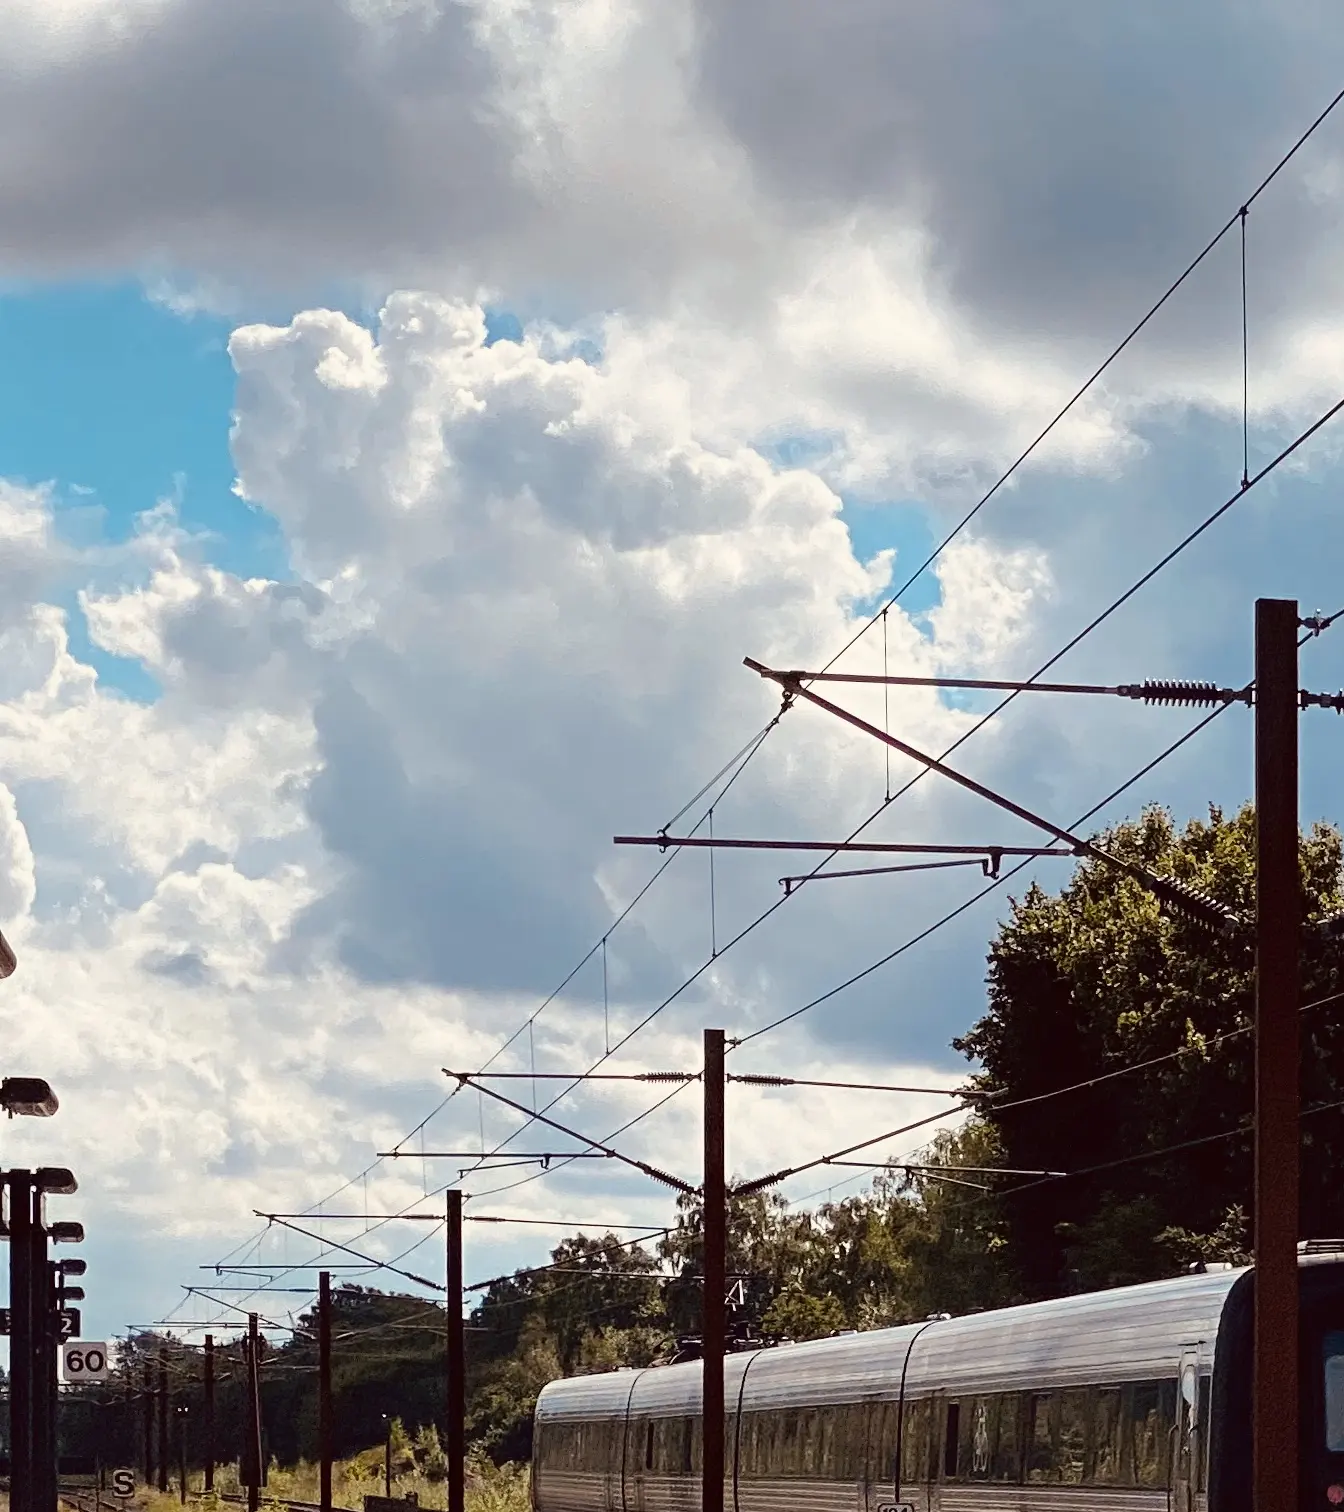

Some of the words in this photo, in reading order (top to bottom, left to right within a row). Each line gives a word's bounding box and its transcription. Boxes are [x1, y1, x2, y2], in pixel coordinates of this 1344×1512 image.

[60, 1318, 72, 1333] 2
[66, 1350, 105, 1372] 60
[114, 1472, 135, 1495] S
